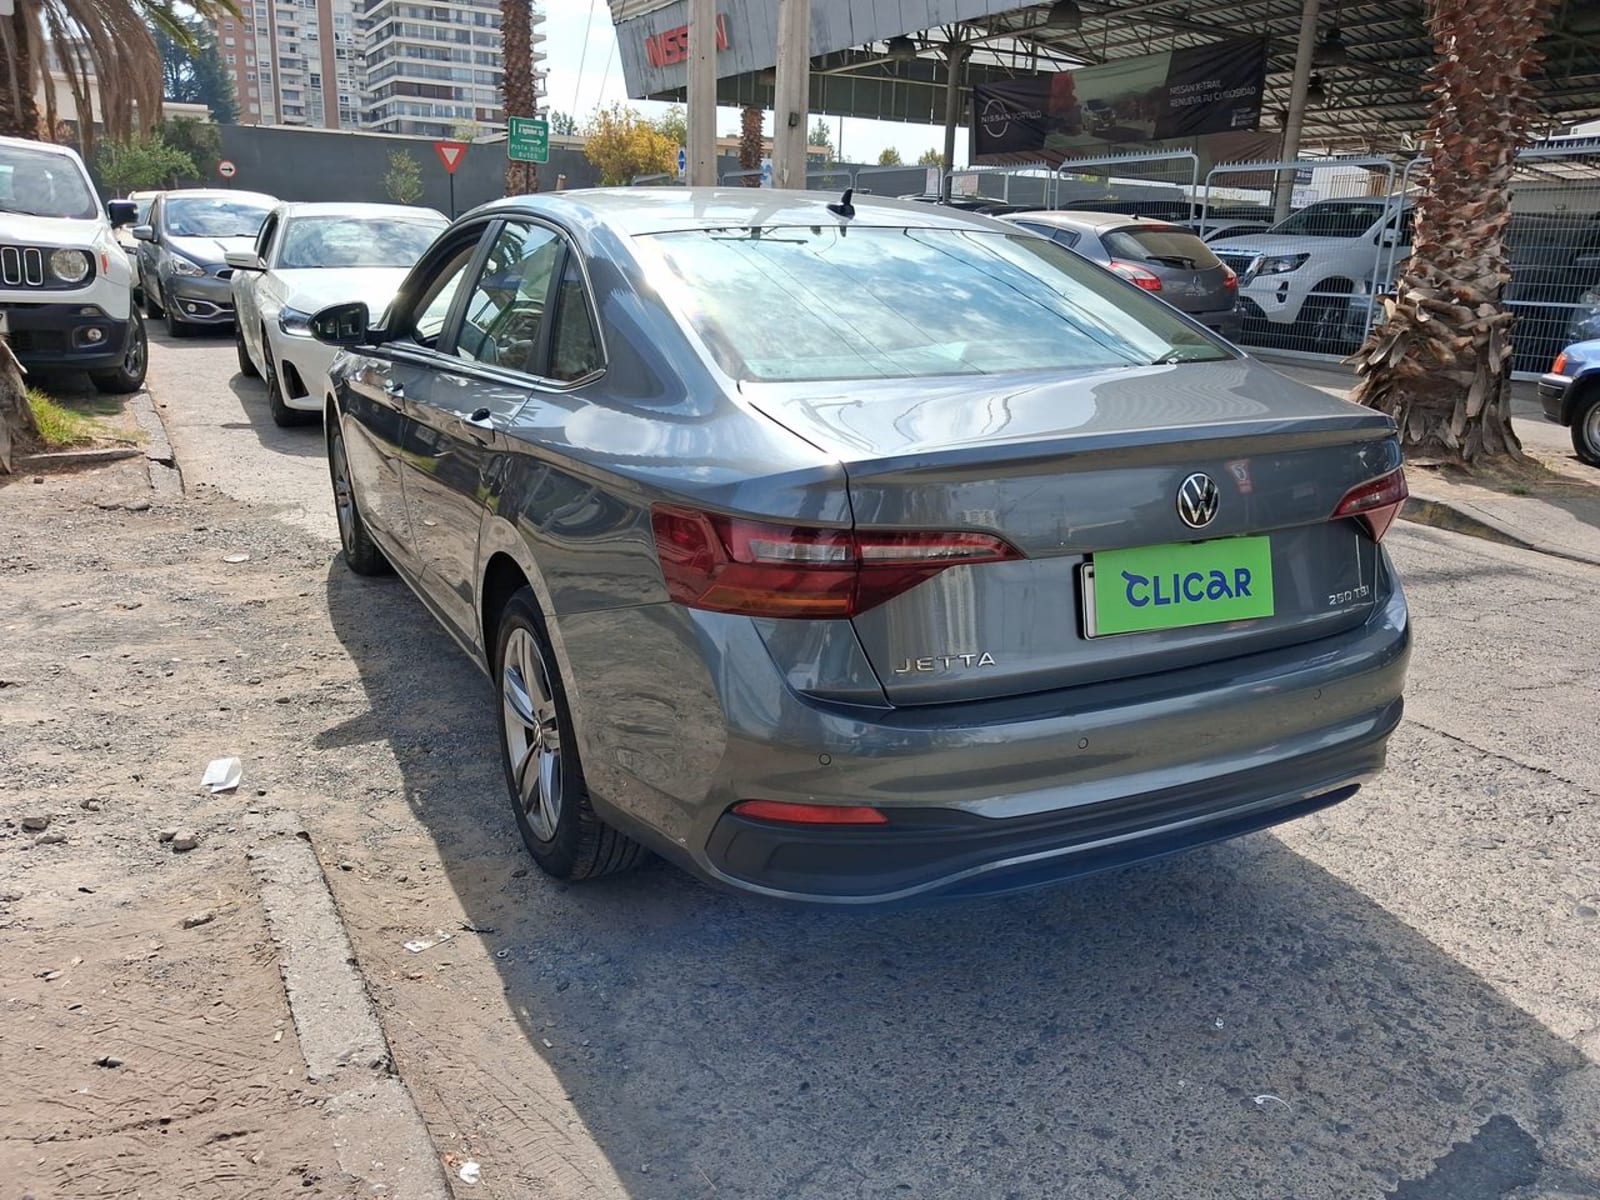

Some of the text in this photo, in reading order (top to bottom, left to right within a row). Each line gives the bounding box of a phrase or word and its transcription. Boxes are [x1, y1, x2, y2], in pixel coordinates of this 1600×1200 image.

[645, 14, 729, 68] NISSN
[1169, 83, 1195, 96] NISSAN
[1203, 94, 1213, 103] TU
[981, 113, 1011, 123] NISSAN
[1328, 585, 1370, 606] 250 TSI
[895, 652, 996, 673] JETTA
